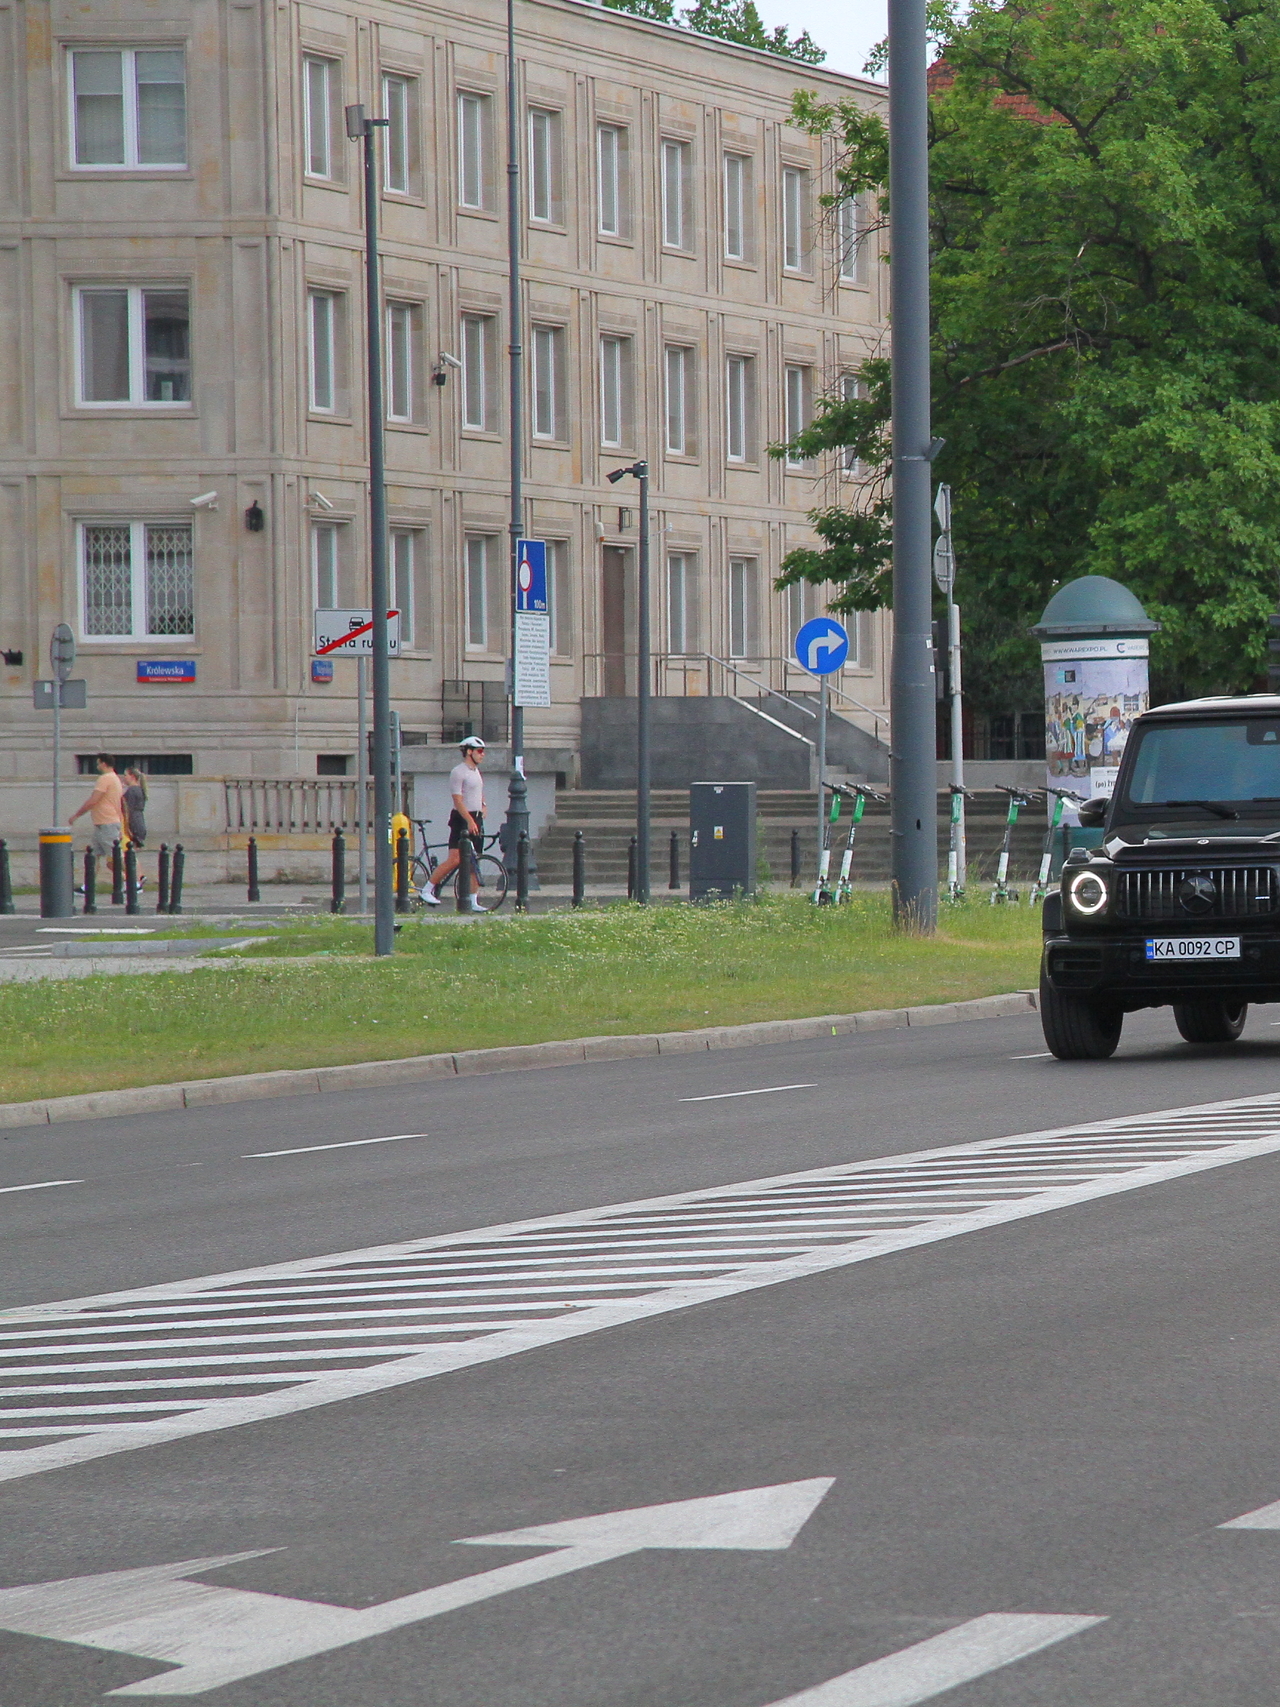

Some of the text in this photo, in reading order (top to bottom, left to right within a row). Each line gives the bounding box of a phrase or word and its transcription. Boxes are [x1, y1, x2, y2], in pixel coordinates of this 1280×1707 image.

[533, 599, 546, 609] 100m
[362, 639, 397, 649] ruu
[146, 665, 184, 675] Królewska
[1154, 940, 1235, 956] KA 0092 CP
